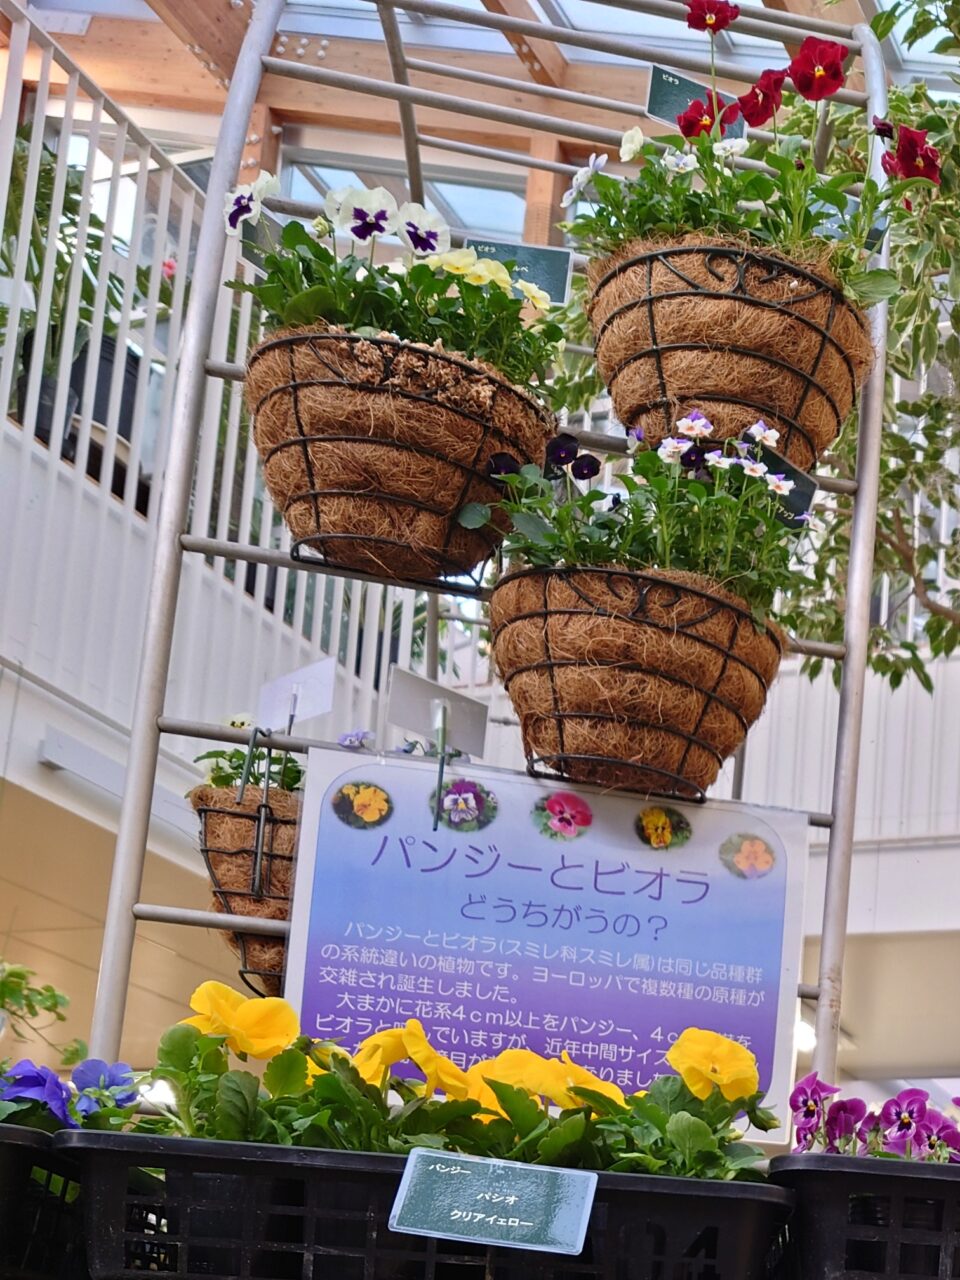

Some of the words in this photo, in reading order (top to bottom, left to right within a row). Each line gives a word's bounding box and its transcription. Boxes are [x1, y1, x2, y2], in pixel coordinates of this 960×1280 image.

[371, 836, 710, 905] パンジーとビオラ
[460, 893, 668, 941] どうちがうの？
[319, 965, 518, 1004] 交雑され誕生しました。
[429, 1163, 472, 1175] パンジー
[476, 1191, 519, 1205] パシオ
